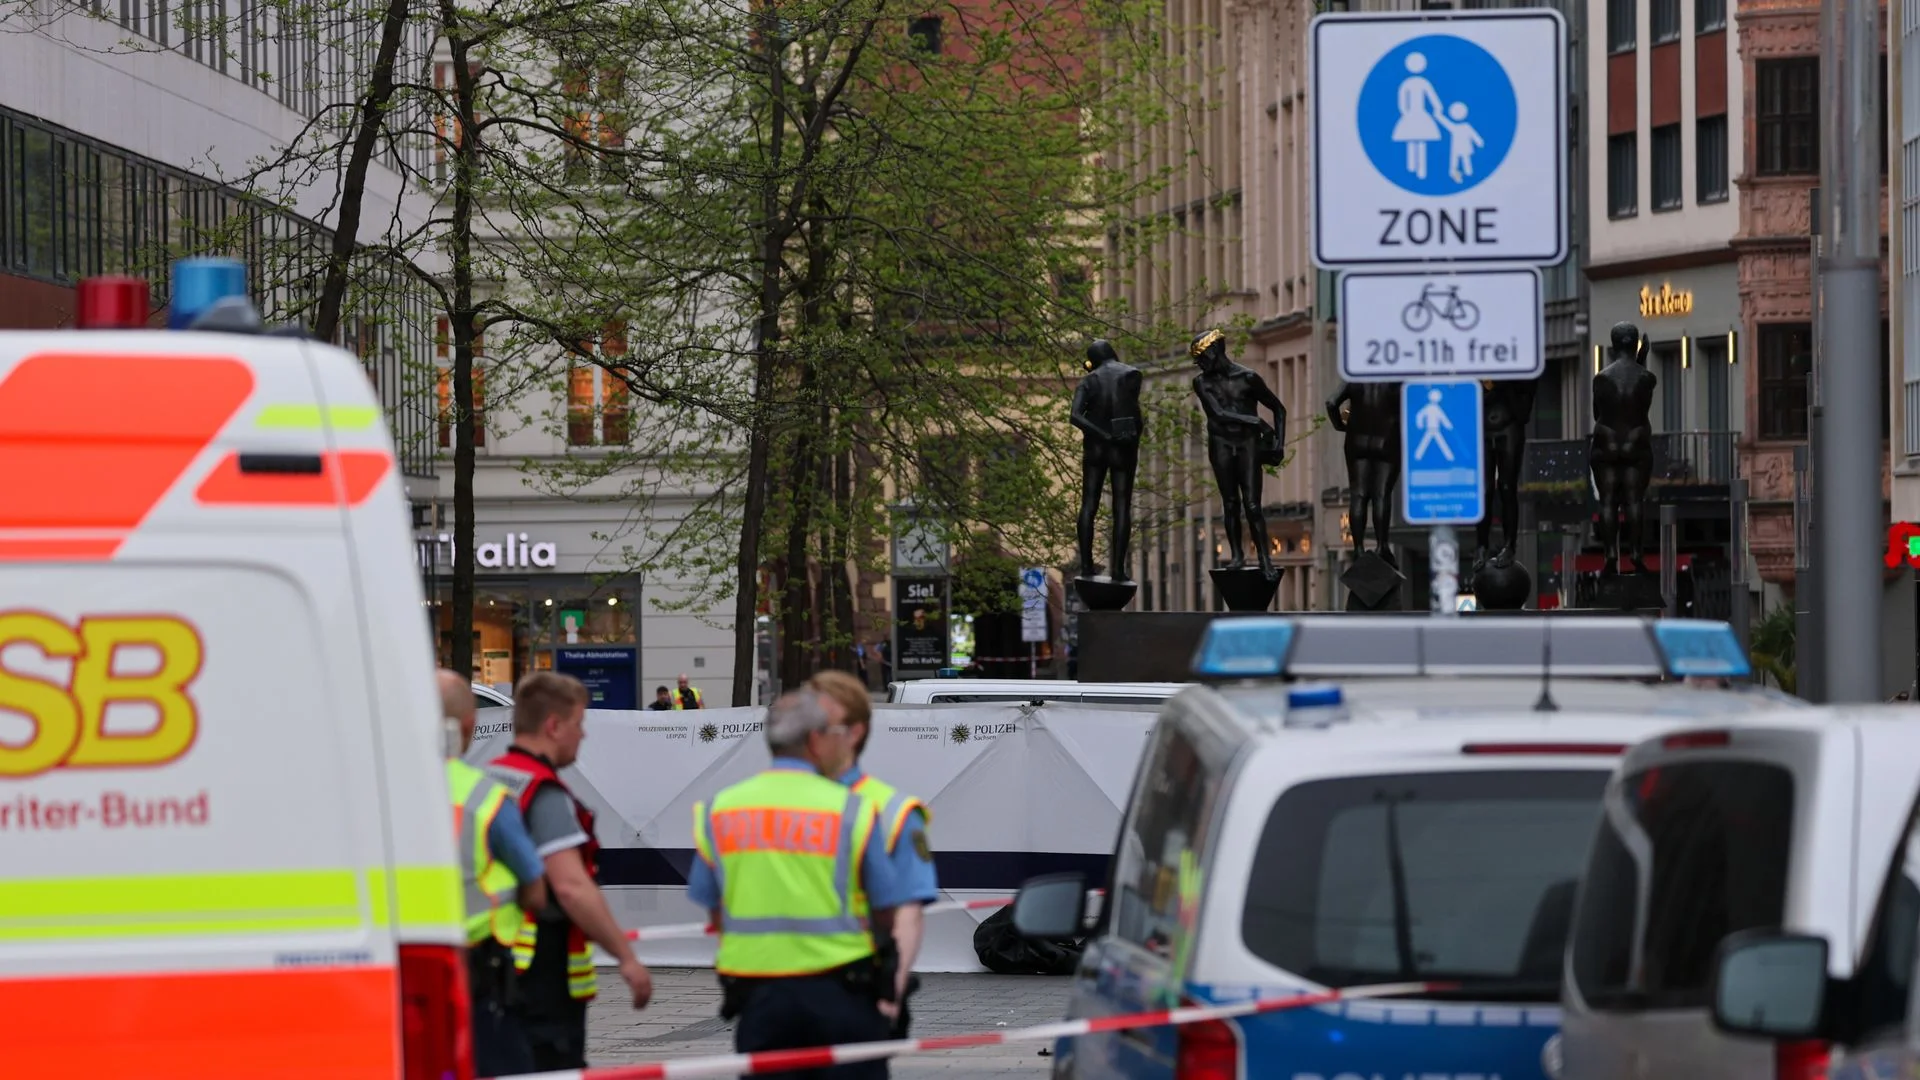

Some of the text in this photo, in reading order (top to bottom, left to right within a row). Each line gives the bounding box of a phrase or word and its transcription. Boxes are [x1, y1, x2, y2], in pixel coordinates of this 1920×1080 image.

[1379, 207, 1498, 246] ZONE
[1366, 336, 1519, 366] 20-11h frei
[908, 584, 934, 598] Sie!
[474, 722, 512, 735] POLIZEI
[722, 722, 763, 733] POLIZEI
[974, 723, 1016, 734] POLIZEI
[719, 810, 835, 852] POLIZEI
